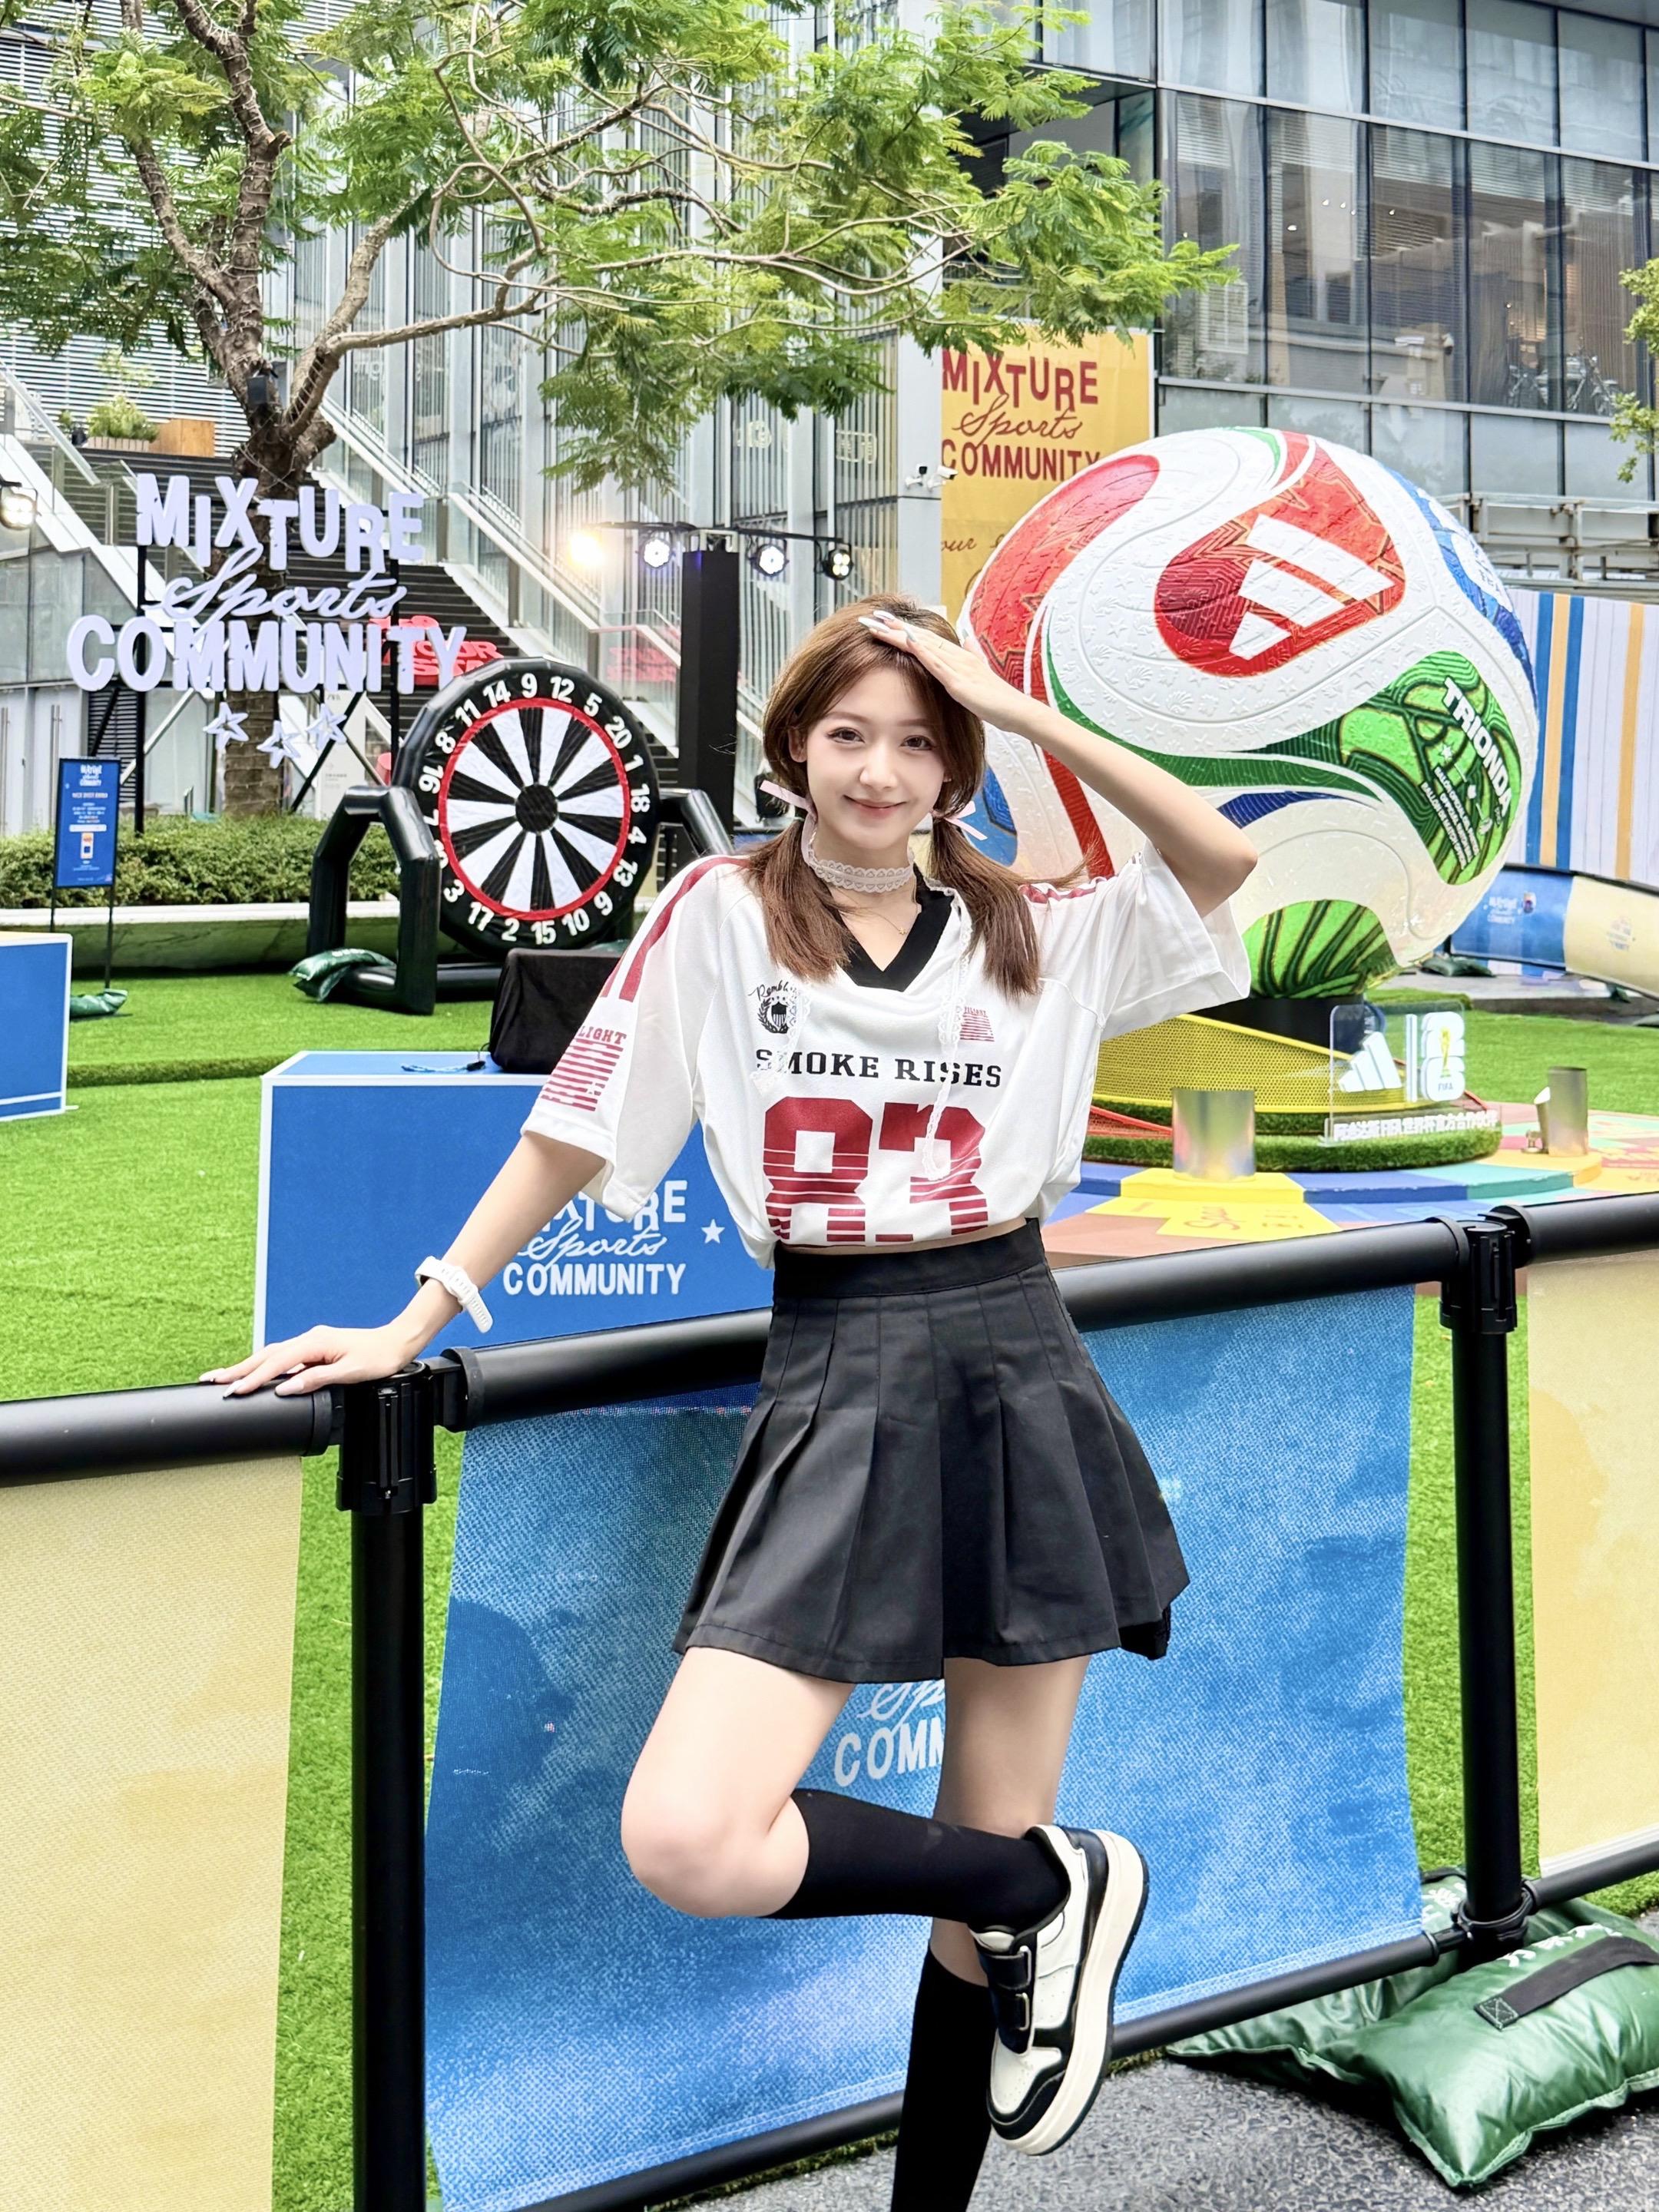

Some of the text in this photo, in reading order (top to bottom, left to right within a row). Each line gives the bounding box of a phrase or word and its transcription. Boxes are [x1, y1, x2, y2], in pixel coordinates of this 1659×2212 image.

[942, 348, 1099, 412] MIXTURE
[952, 392, 1083, 449] Sports
[135, 473, 425, 573] MIXTURE
[141, 541, 408, 642] Sports
[66, 614, 468, 694] COMMUNITY
[482, 680, 512, 708] 14
[521, 673, 538, 698] 9
[549, 676, 575, 703] 12
[455, 698, 482, 727] 11
[583, 692, 603, 717] 5
[435, 731, 457, 754] 8
[604, 715, 632, 749] 20
[1442, 676, 1512, 817] TRIONDA
[624, 753, 644, 772] 1
[630, 783, 651, 813] 18
[628, 826, 647, 845] 4
[612, 858, 639, 887] 13
[442, 879, 465, 903] 3
[467, 901, 495, 932] 17
[501, 917, 520, 942] 2
[561, 907, 591, 936] 10
[530, 921, 557, 945] 15
[894, 1058, 1002, 1088] RISES
[516, 1215, 668, 1272] Sports
[502, 1261, 687, 1296] COMMUNITY
